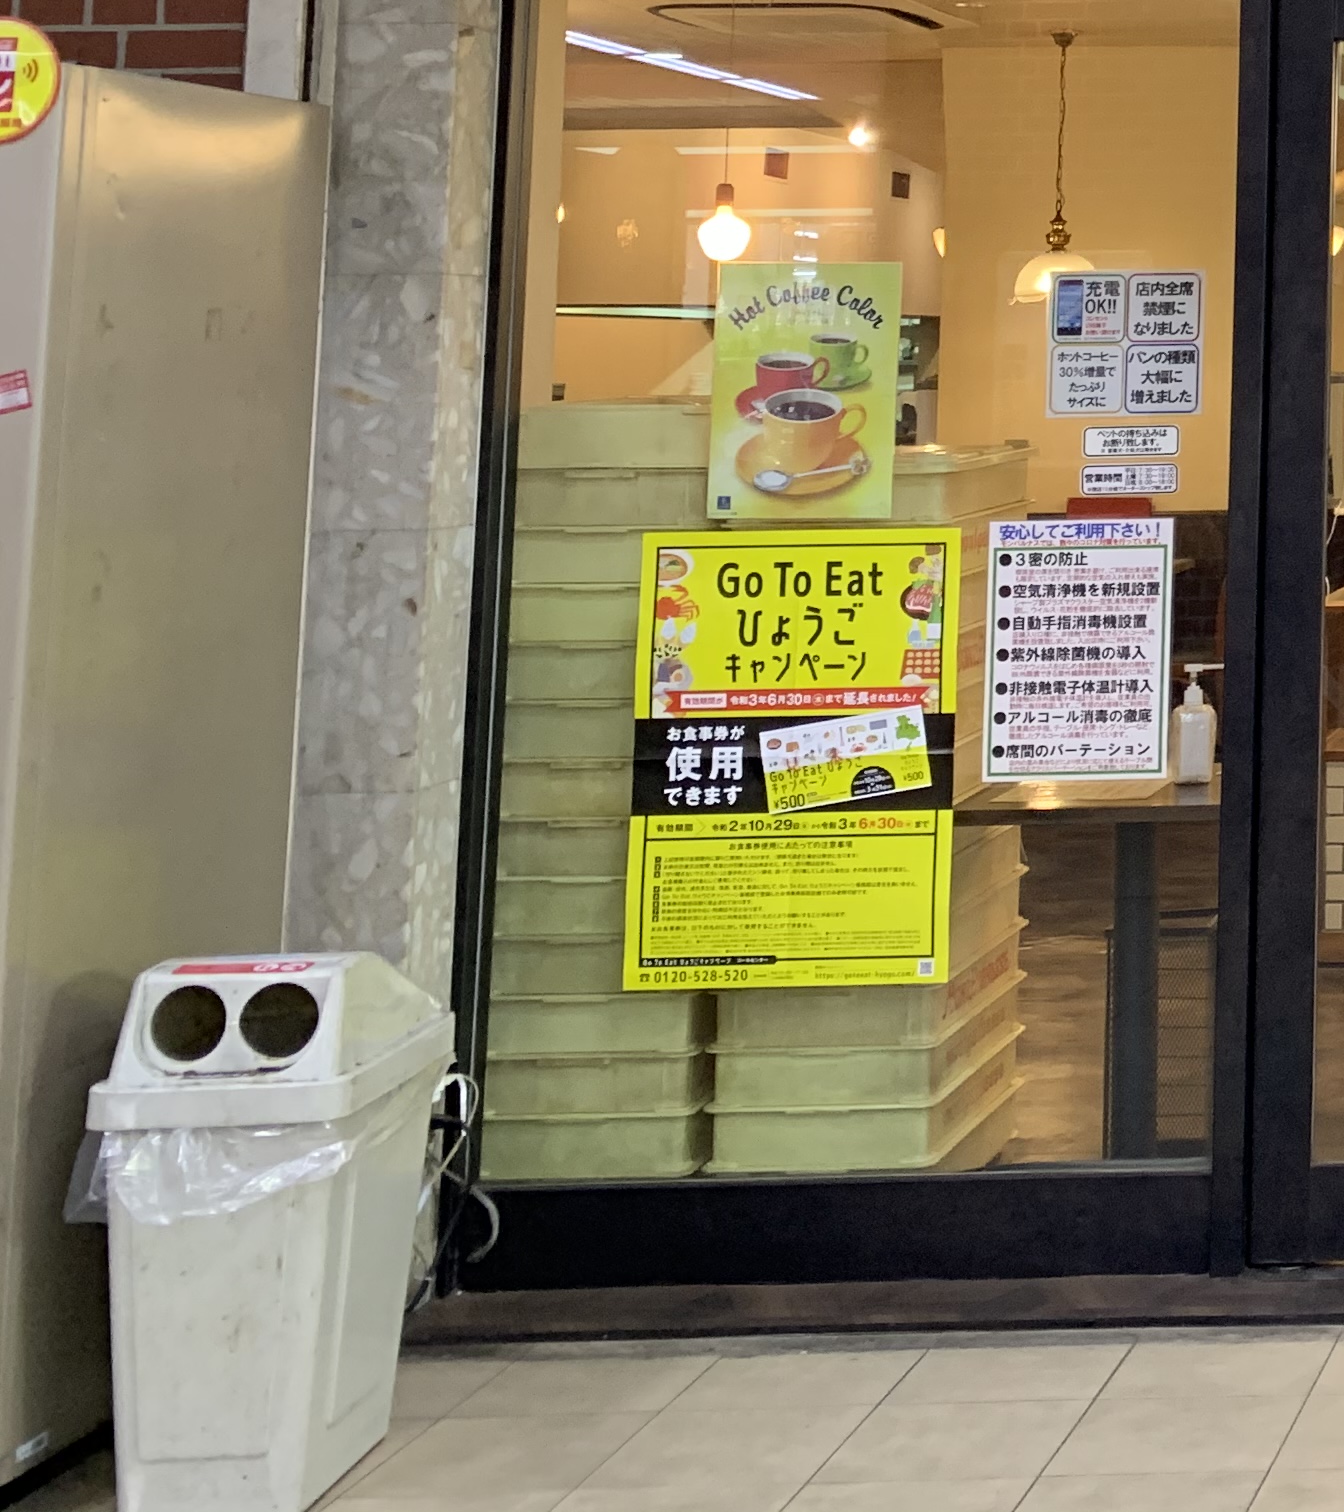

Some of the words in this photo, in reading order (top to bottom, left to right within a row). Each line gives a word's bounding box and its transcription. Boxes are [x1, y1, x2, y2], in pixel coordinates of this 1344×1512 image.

[1085, 281, 1121, 297] 充電
[1135, 281, 1194, 297] 店内全席
[728, 297, 766, 332] Hot
[766, 281, 830, 308] Coffee
[836, 285, 886, 331] Color
[1085, 299, 1117, 315] OK!!
[1142, 300, 1187, 316] 禁煙に
[1133, 321, 1194, 336] なりました
[1057, 351, 1120, 363] ホットコーヒー
[1128, 349, 1196, 365] パンの種類
[1141, 369, 1184, 385] 大幅に
[1068, 381, 1106, 393] たっぷり
[1066, 396, 1107, 408] サイズに
[1130, 389, 1193, 405] 増えました
[1085, 472, 1123, 484] 営業時間
[1000, 522, 1161, 540] 安心してご利用下さい！
[717, 562, 764, 598] Go
[773, 561, 812, 598] To
[825, 561, 883, 597] Eat
[736, 602, 864, 647] ひょうご
[725, 651, 867, 684] キャンペーン
[666, 725, 746, 742] お食事券が
[665, 746, 745, 783] 使用
[769, 771, 784, 783] Go
[803, 763, 822, 778] Eat
[903, 770, 925, 783] ¥500
[663, 785, 744, 807] できます
[773, 792, 806, 810] ¥500
[653, 968, 749, 984] 0120-528-520
